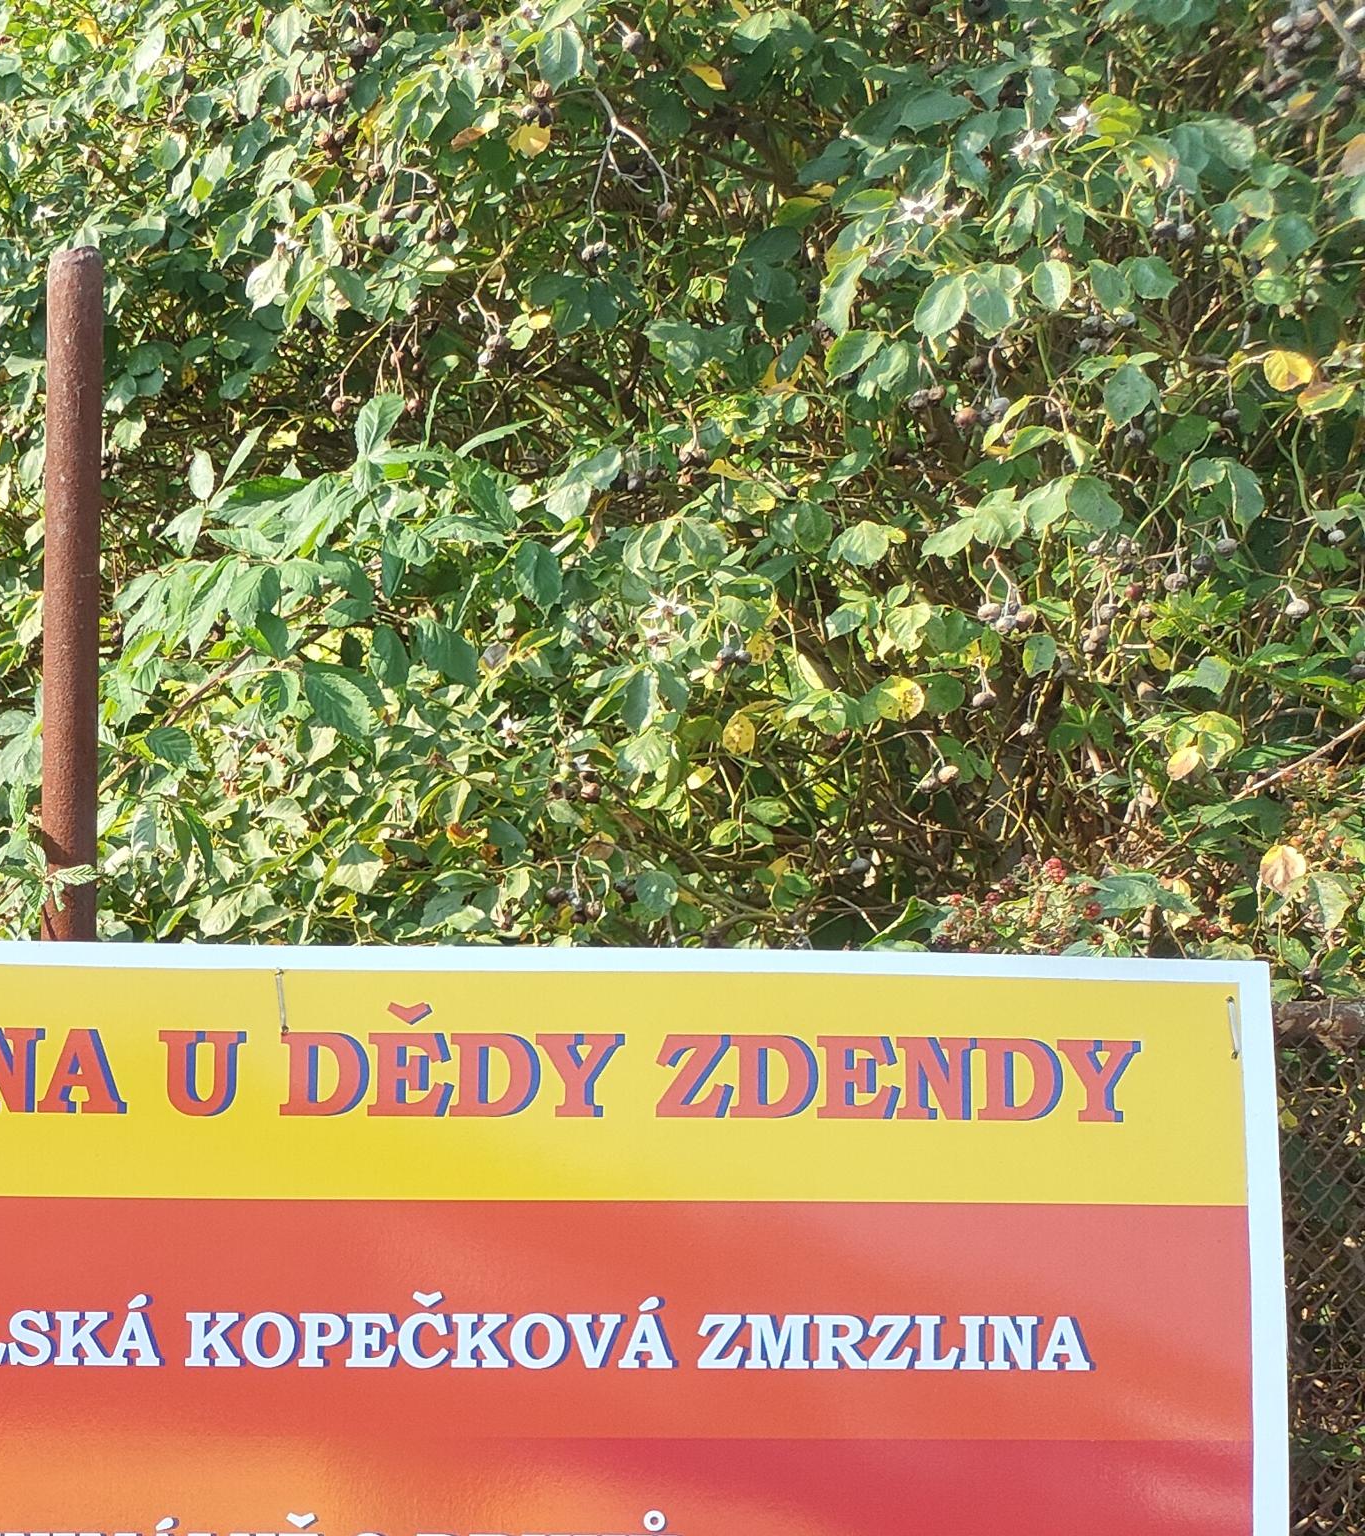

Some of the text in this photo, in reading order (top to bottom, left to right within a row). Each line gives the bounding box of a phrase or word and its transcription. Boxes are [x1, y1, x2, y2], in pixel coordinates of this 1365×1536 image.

[159, 1029, 247, 1117] U
[279, 1002, 626, 1118] DĚDY
[655, 1033, 1142, 1123] ZDENDY
[184, 1291, 679, 1370] KOPEČKOVÁ
[697, 1315, 1096, 1371] ZMRZLINA
